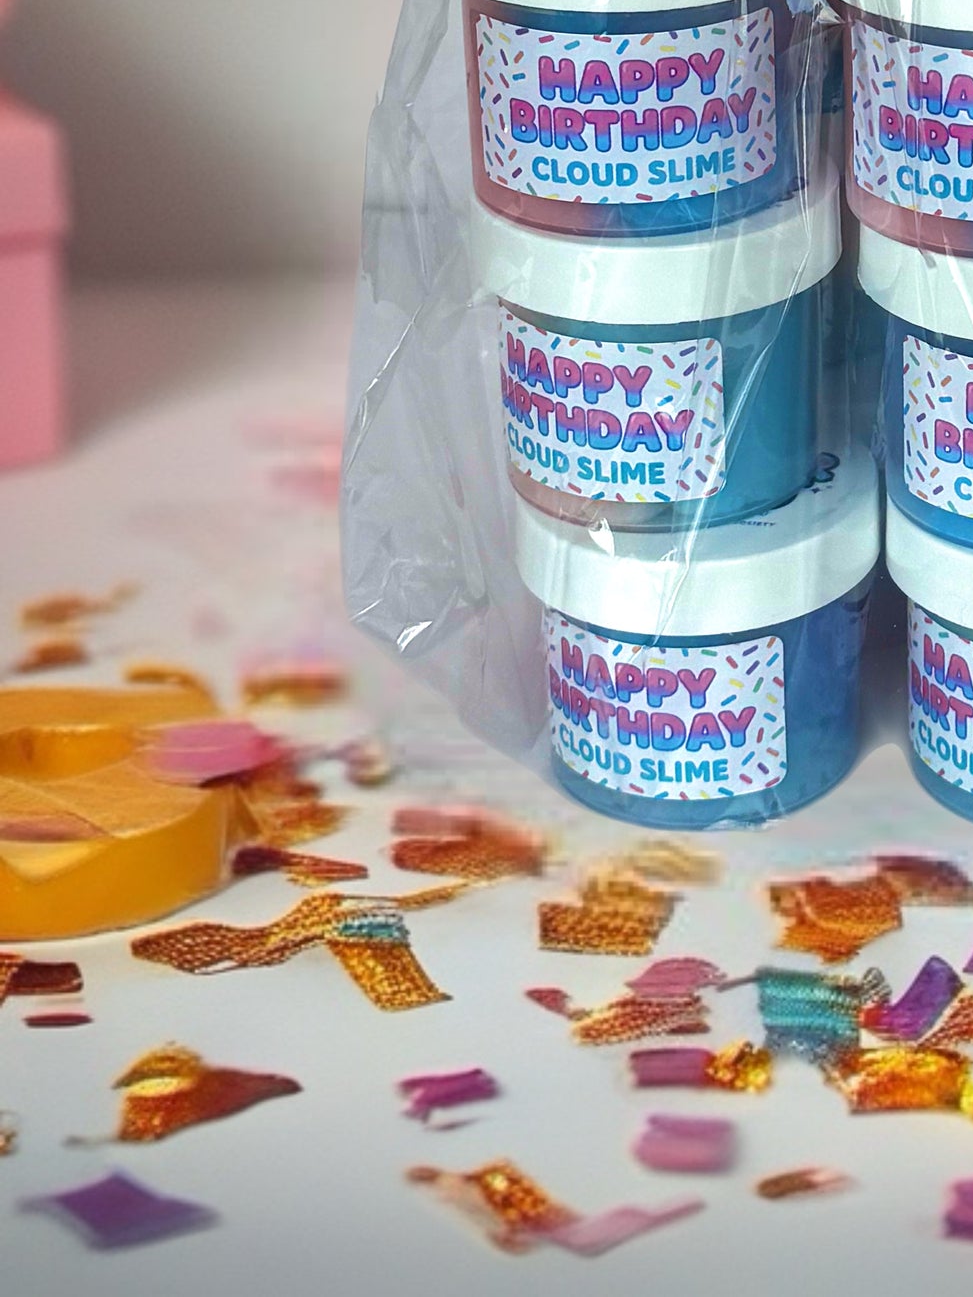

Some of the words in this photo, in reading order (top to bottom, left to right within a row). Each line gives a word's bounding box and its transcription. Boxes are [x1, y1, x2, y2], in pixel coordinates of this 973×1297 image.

[538, 48, 726, 105] HAPPY
[509, 87, 757, 152] BIRTHDAY
[532, 156, 638, 186] CLOUD
[648, 147, 735, 184] SLIME
[507, 332, 653, 408] HAPPY
[508, 422, 570, 473] CLOUD
[577, 456, 666, 485] SLIME
[561, 637, 717, 709] HAPPY
[559, 723, 632, 775] CLOUD
[640, 758, 729, 783] SLIME
